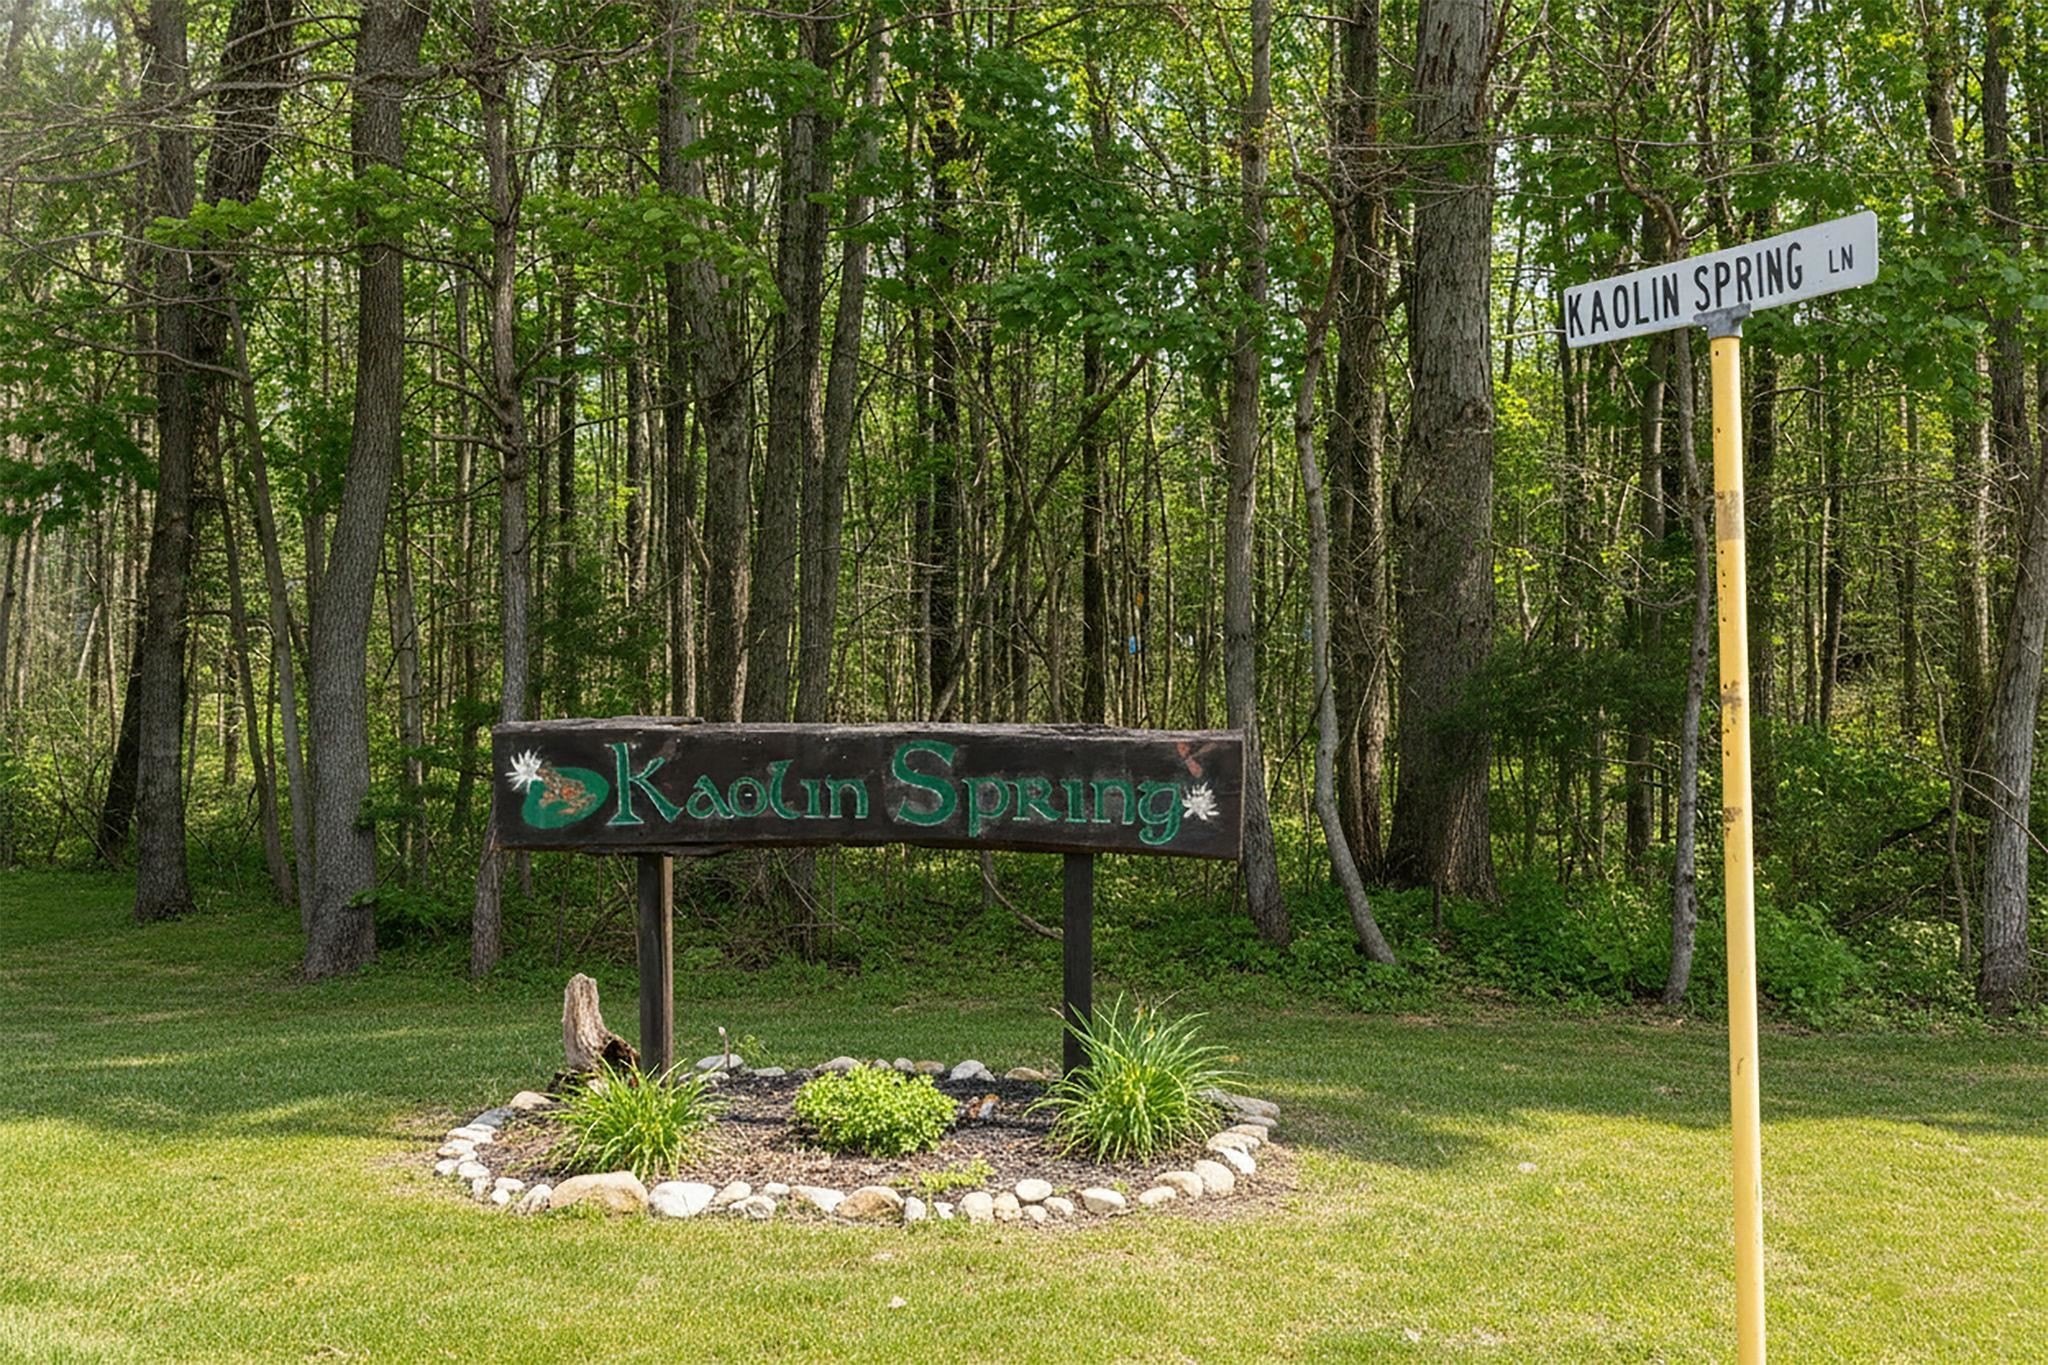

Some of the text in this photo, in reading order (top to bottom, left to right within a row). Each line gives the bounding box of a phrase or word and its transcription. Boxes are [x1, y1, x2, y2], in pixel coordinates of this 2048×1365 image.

[1568, 242, 1853, 338] KAOLIN SPRING LN
[605, 740, 1182, 845] Kaolin Spring
